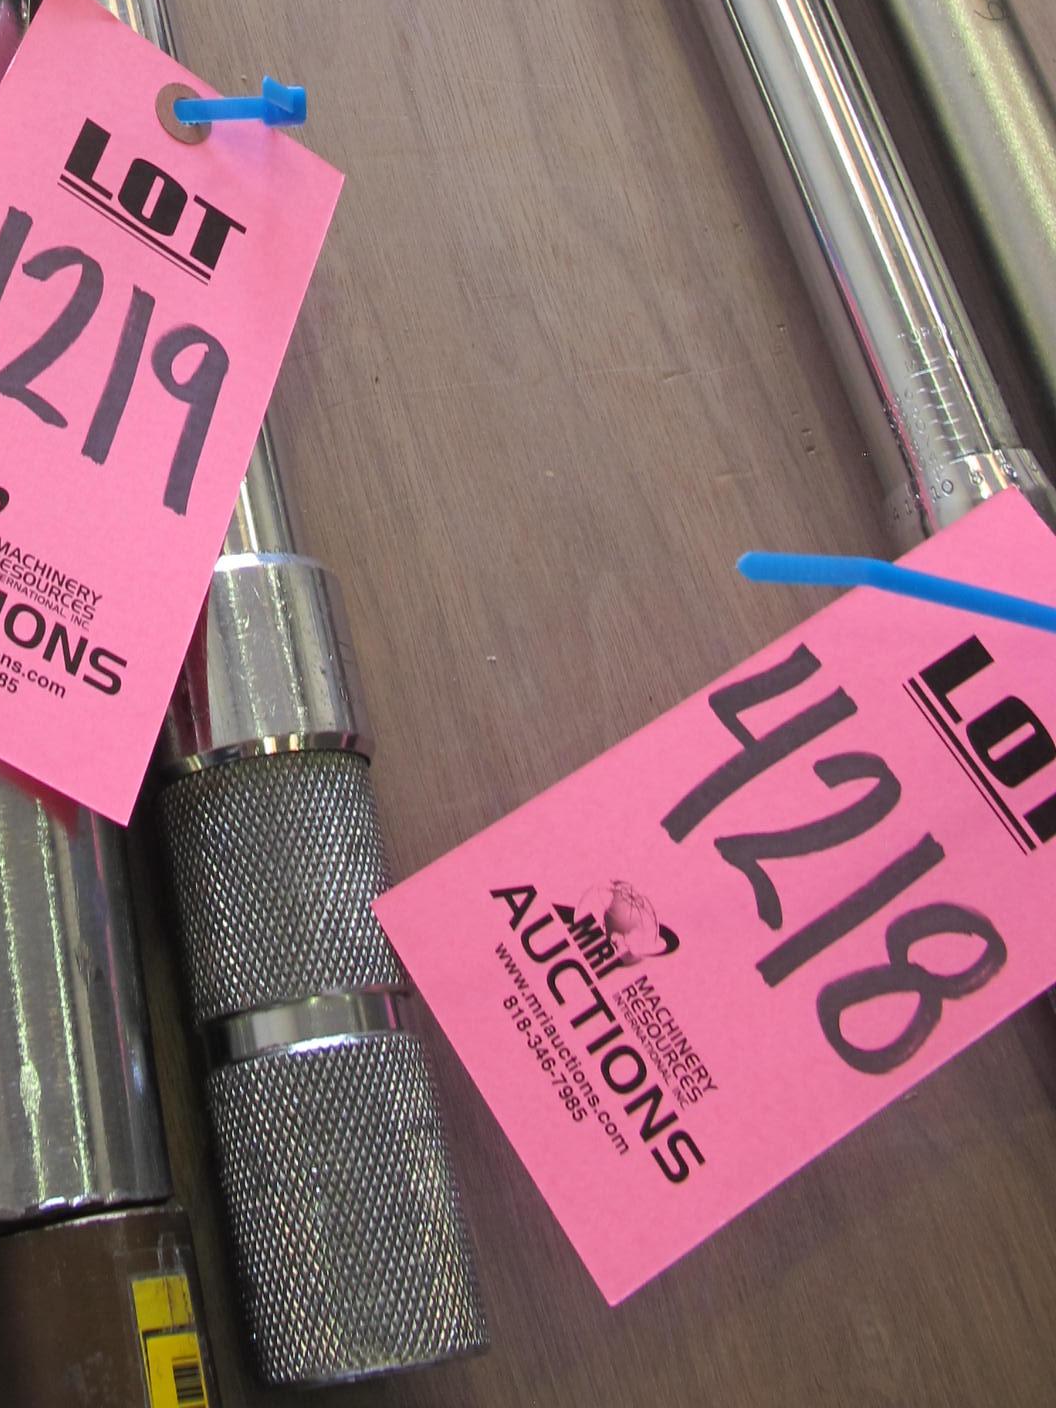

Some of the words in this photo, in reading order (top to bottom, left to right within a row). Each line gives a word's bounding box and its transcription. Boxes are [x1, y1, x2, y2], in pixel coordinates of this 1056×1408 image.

[61, 117, 247, 272] LOT
[659, 642, 1009, 1076] 4218
[569, 911, 624, 980] MRI
[489, 884, 706, 1184] AUCTIONS
[494, 941, 630, 1156] www.mriauctions.com
[502, 994, 588, 1123] 818-346-7985
[612, 992, 672, 1086] INTERNATIONAL
[620, 983, 703, 1105] RESOURCES
[634, 974, 719, 1093] MACHINERY
